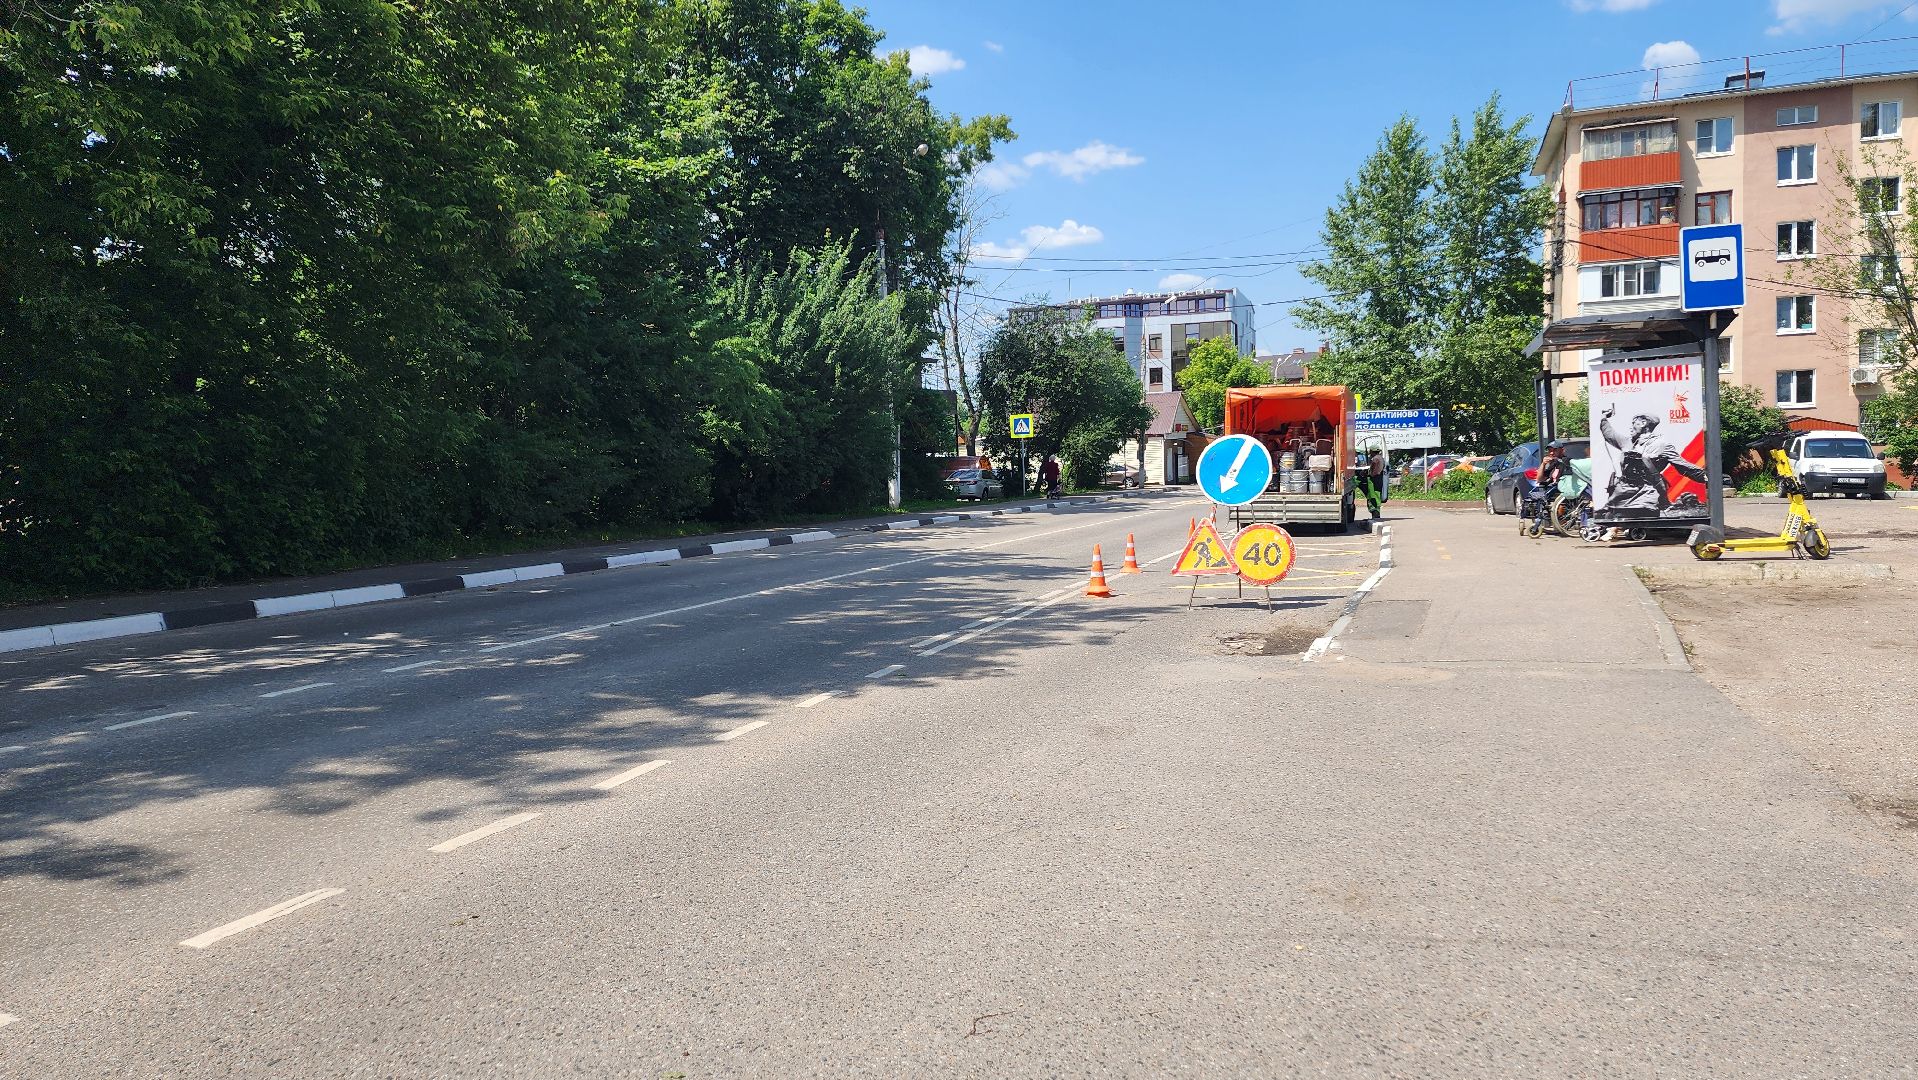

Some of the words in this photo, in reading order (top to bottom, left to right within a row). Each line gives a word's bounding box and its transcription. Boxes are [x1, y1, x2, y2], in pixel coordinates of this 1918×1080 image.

[1599, 363, 1690, 387] ПОМНИМ!
[1354, 411, 1419, 419] ОНСТАНТИНОВО
[1242, 542, 1282, 566] 40
